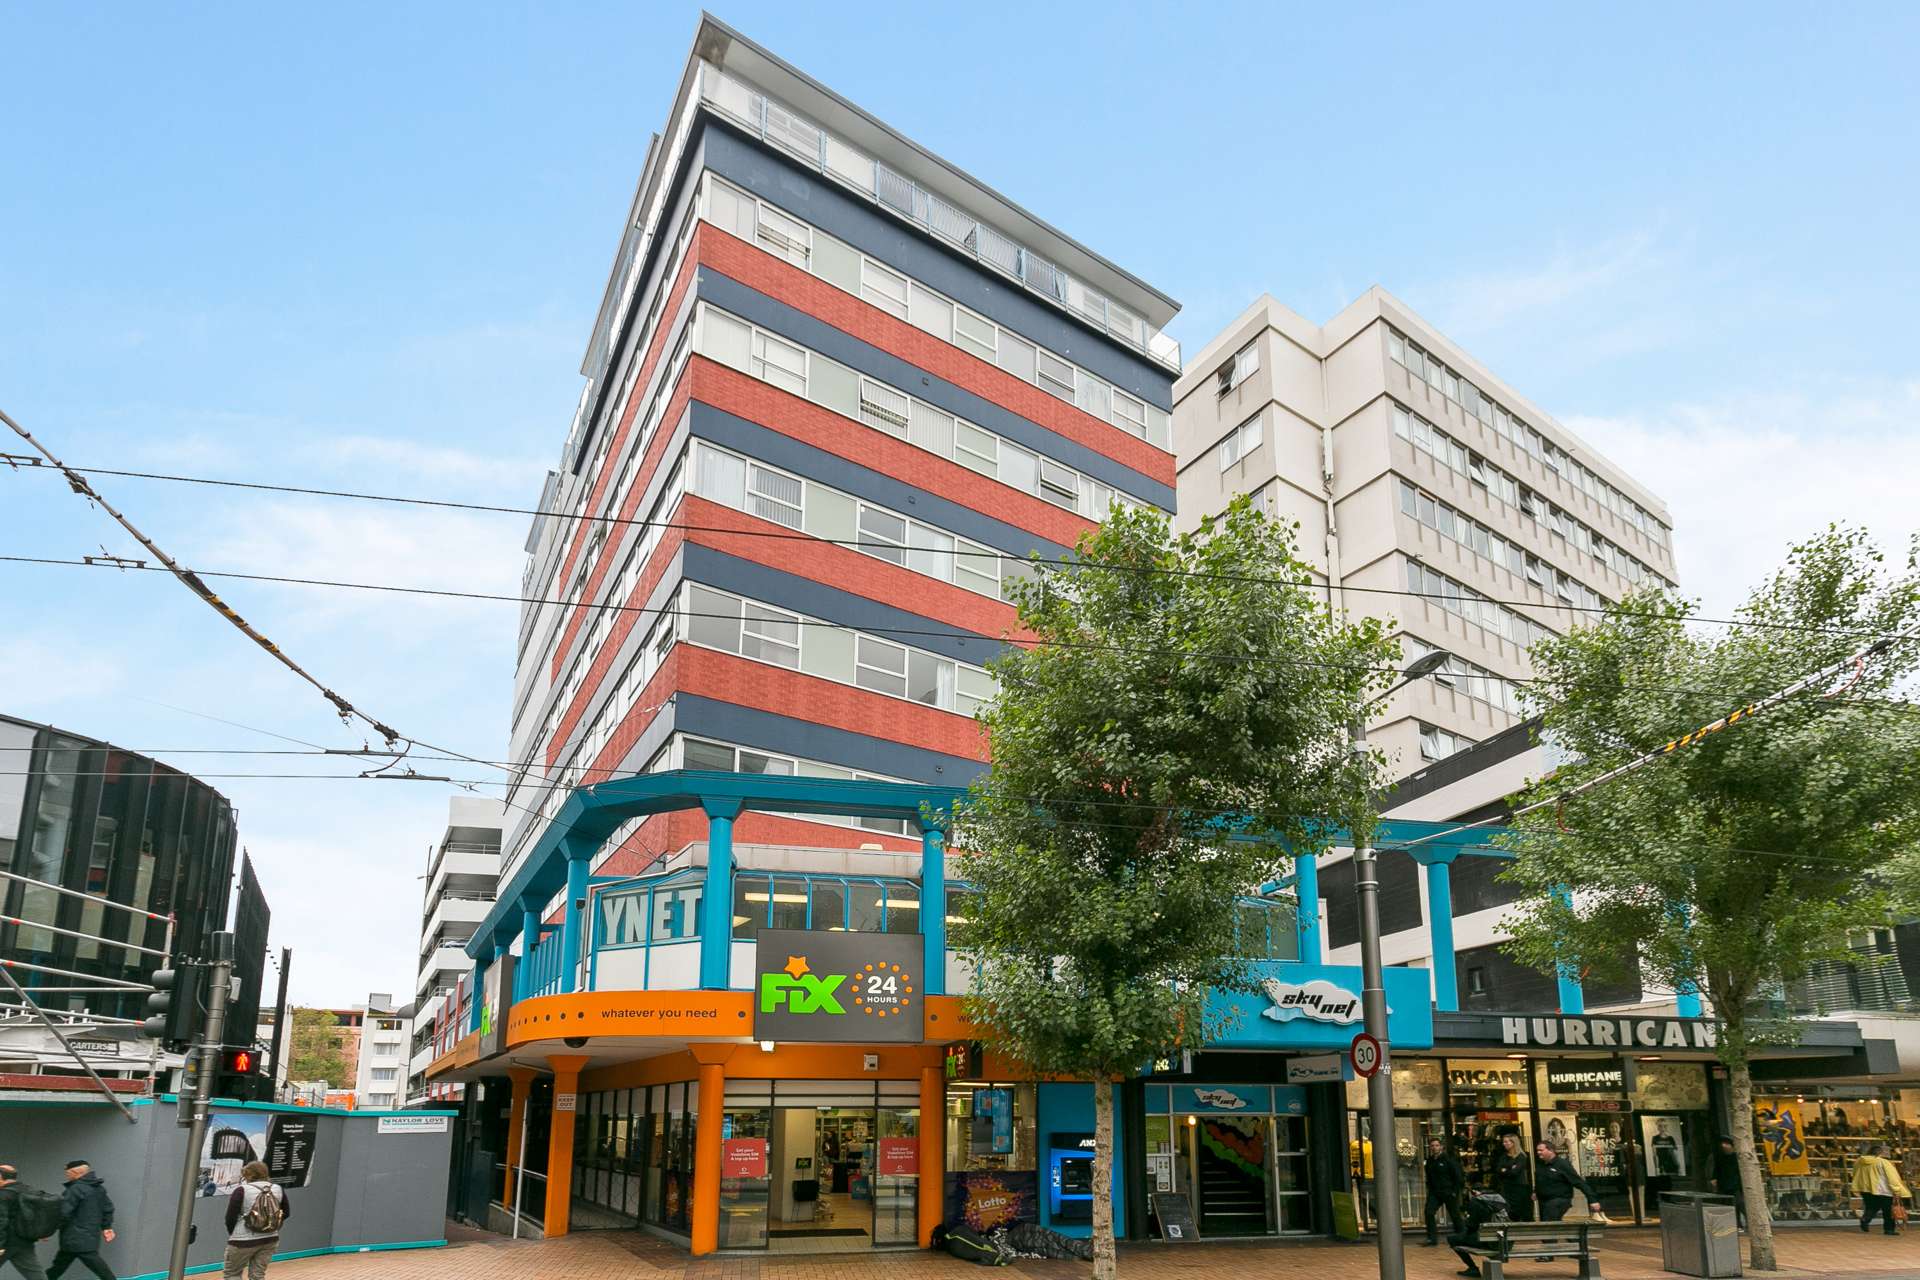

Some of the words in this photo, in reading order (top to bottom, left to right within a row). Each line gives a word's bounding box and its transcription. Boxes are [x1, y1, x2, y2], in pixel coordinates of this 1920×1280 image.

[602, 888, 703, 944] YNET
[867, 976, 898, 994] 24
[1281, 990, 1323, 1009] sky
[601, 1009, 654, 1018] whatever
[658, 1009, 681, 1020] you
[685, 1009, 717, 1018] need
[1319, 1000, 1357, 1018] net
[1502, 1017, 1728, 1047] HURRICAN
[1358, 1047, 1375, 1064] 30
[1550, 1071, 1622, 1084] HURRICANE
[1581, 1127, 1606, 1138] SALE
[978, 1197, 1007, 1209] Lotto
